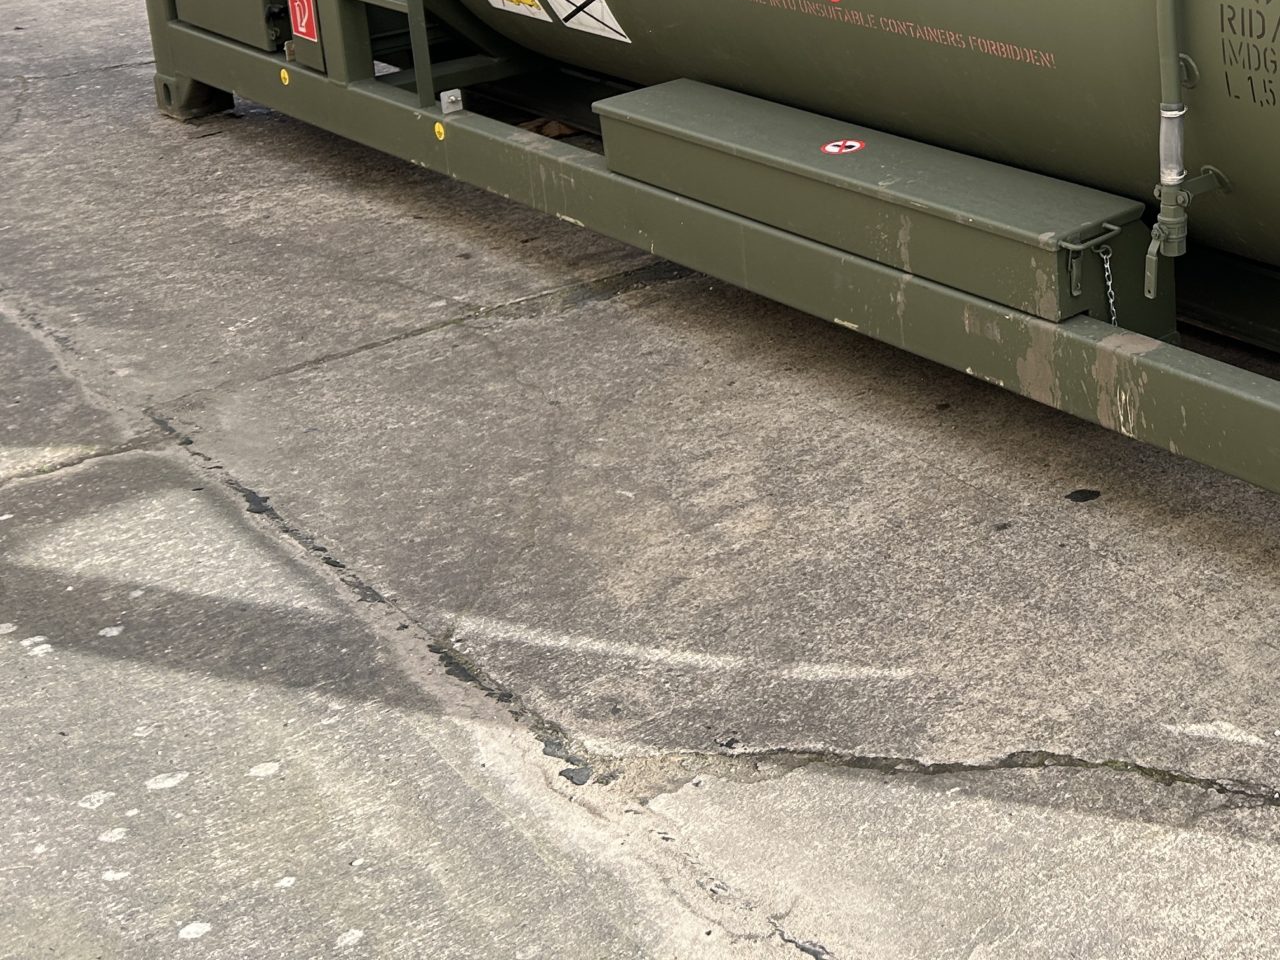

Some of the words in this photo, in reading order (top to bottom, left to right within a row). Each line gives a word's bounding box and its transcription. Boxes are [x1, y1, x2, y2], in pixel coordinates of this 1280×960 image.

[799, 0, 877, 29] UNSUITABLE
[880, 16, 966, 49] CONTAINERS
[968, 35, 1057, 69] FORBIDDEN!
[1221, 38, 1278, 74] IMDG
